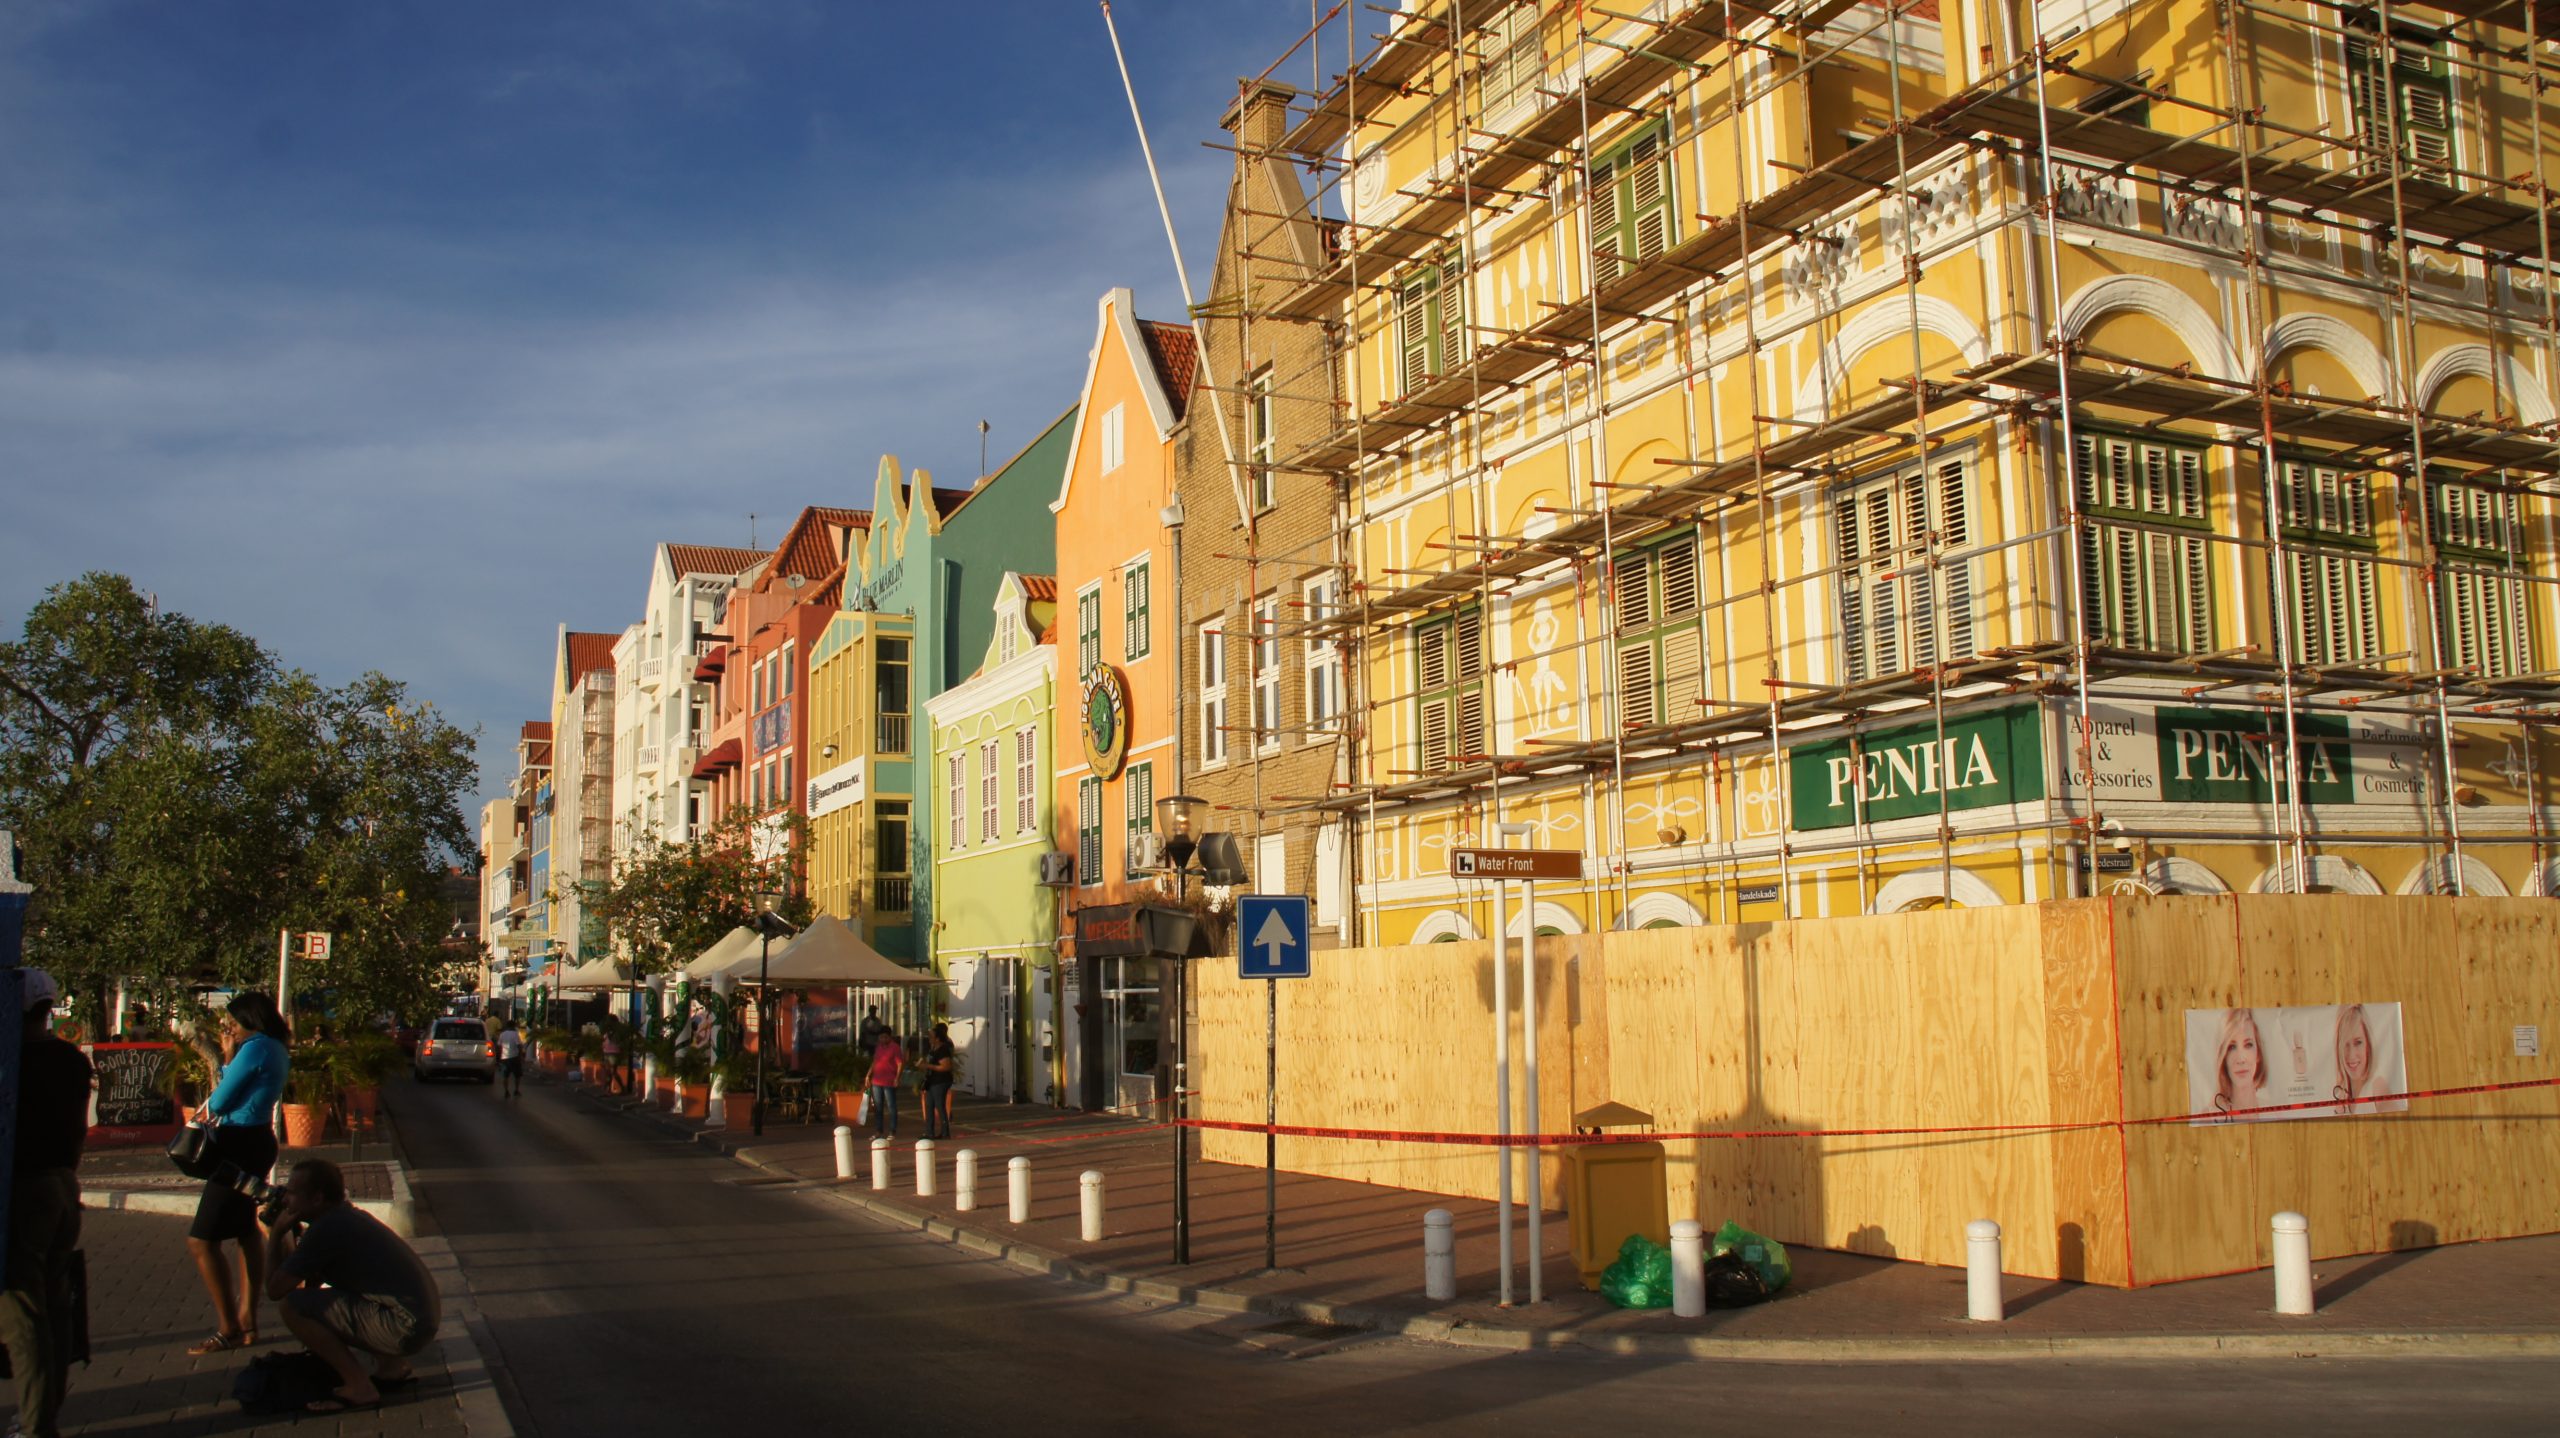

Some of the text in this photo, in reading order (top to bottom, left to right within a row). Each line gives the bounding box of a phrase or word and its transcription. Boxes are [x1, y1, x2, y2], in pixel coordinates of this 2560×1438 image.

[878, 557, 904, 595] MARLIN
[1081, 667, 1104, 723] IGUANA
[2097, 741, 2111, 761] &
[1826, 732, 1998, 807] PENHA
[2389, 752, 2401, 770] &
[2363, 775, 2425, 794] Cosmetic
[1478, 856, 1534, 872] Water Front
[2082, 857, 2131, 868] Bedestraat
[310, 936, 325, 955] B
[115, 1066, 160, 1088] HAPPY
[110, 1085, 145, 1101] HOUR
[1315, 1130, 1349, 1138] DANGER
[1399, 1134, 1436, 1142] DANGER
[1443, 1135, 1482, 1143] DANGER
[1491, 1136, 1539, 1145] DANGER
[1552, 1135, 1603, 1143] DANGER
